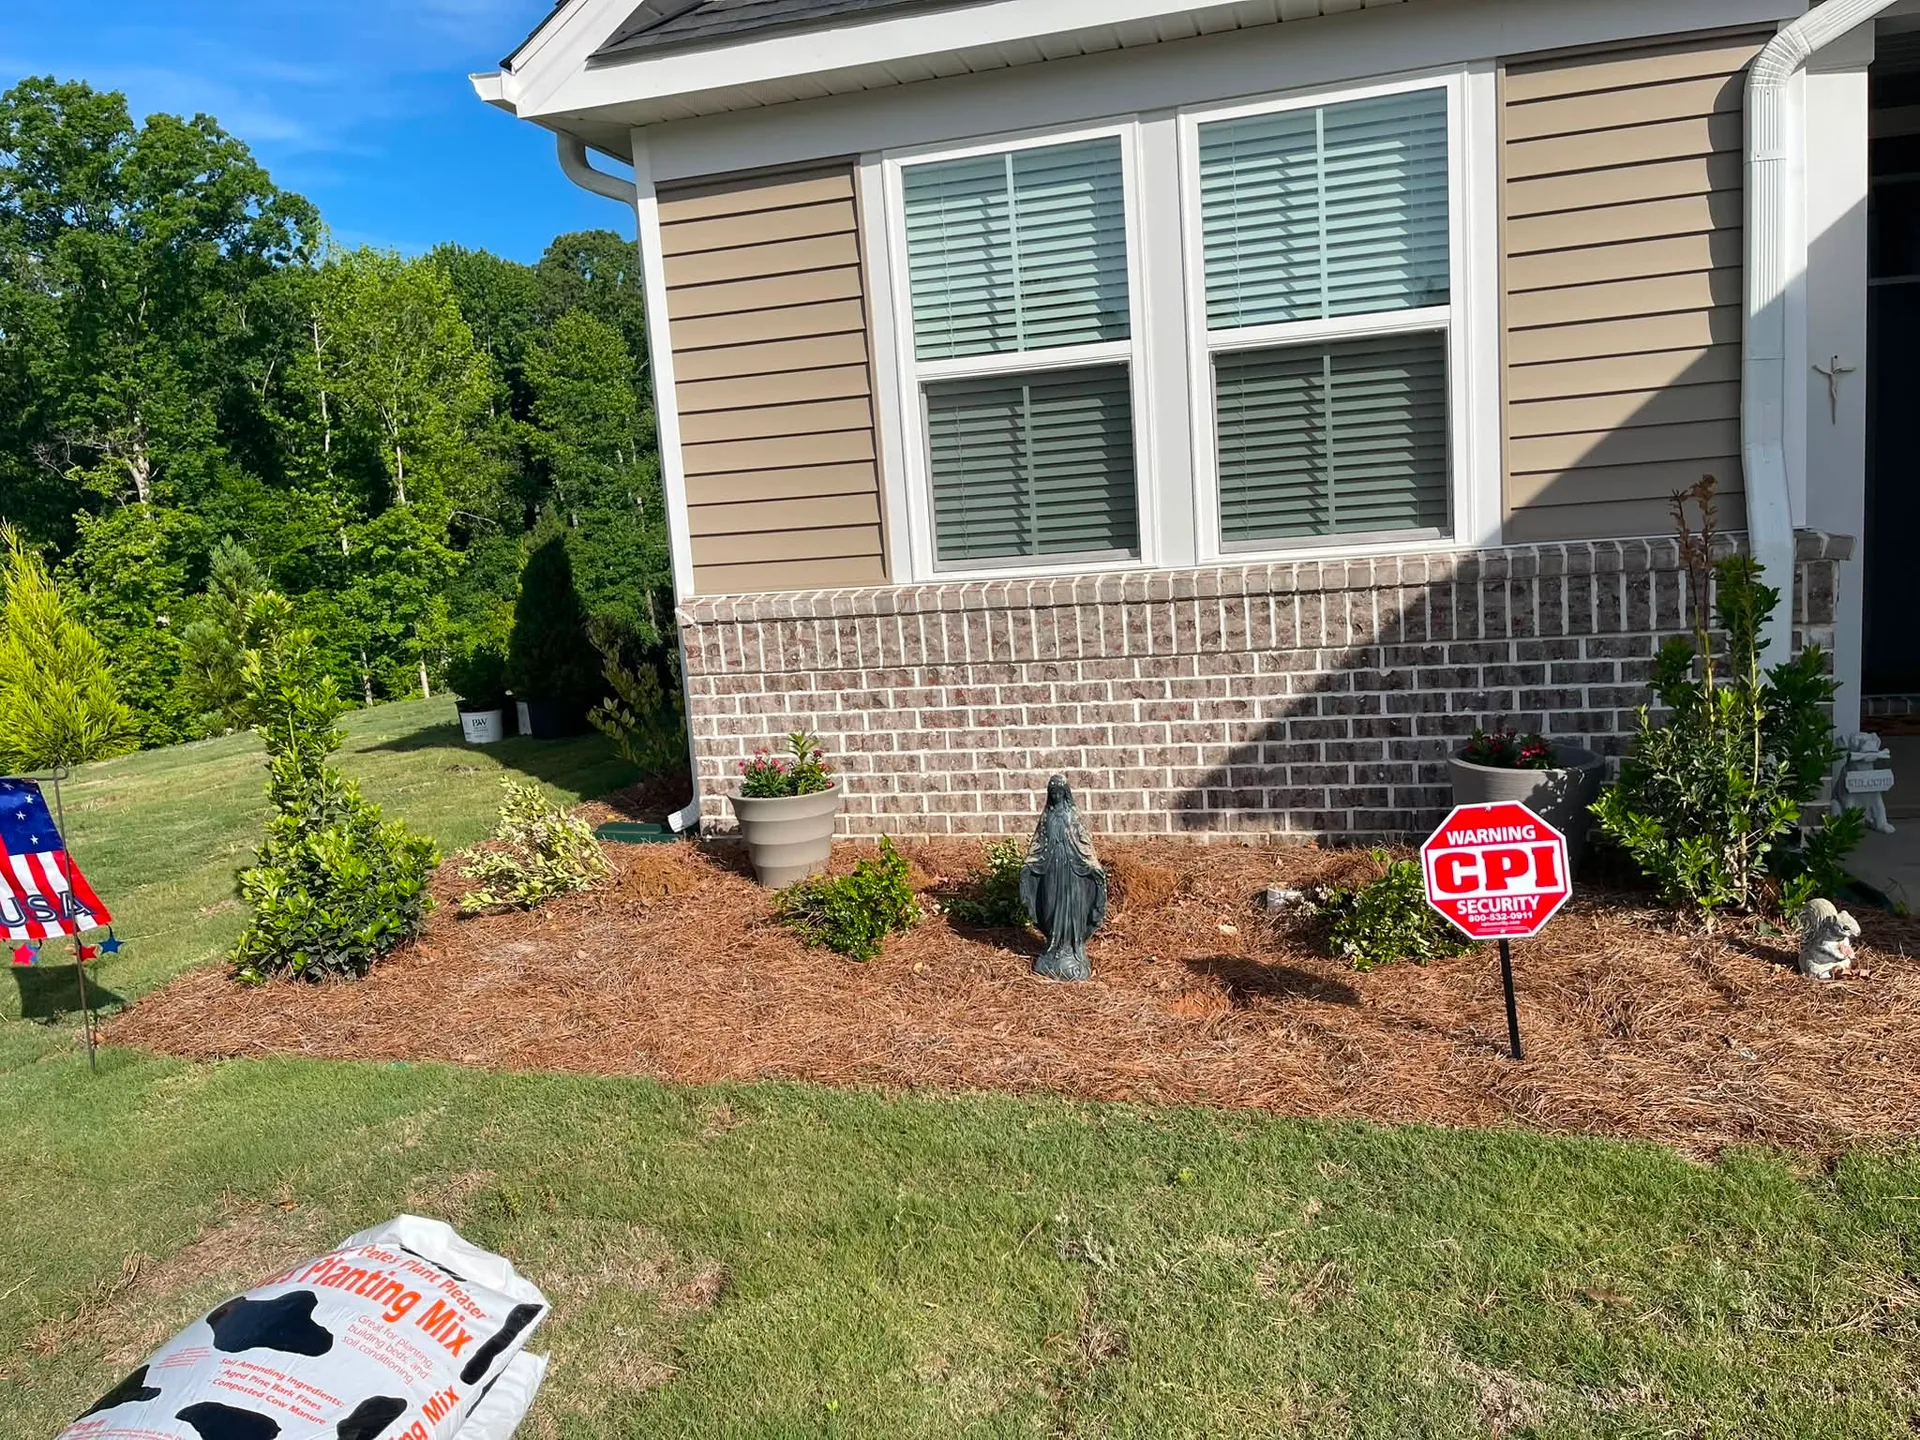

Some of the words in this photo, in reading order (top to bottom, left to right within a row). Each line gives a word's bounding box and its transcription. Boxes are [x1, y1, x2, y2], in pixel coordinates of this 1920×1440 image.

[1446, 825, 1536, 845] WARNING
[1434, 846, 1558, 893] CPI
[0, 890, 99, 928] USA
[1456, 895, 1540, 915] SECURITY
[1468, 911, 1532, 922] 800-532-0911
[297, 1257, 422, 1323] Planting
[415, 1298, 474, 1358] Mix
[399, 1259, 442, 1283] Plant
[438, 1278, 486, 1319] Pleaser
[342, 1335, 361, 1349] soil
[358, 1314, 384, 1332] Great
[382, 1327, 399, 1340] for
[348, 1324, 385, 1349] building
[409, 1362, 431, 1380] and
[211, 1378, 266, 1398] Composted
[264, 1394, 289, 1408] Cow
[288, 1405, 326, 1425] Manure
[220, 1357, 238, 1366] Soil
[237, 1360, 285, 1381] Amending
[287, 1375, 345, 1408] Ingredients:
[221, 1369, 248, 1380] Aged
[248, 1374, 271, 1388] Pine
[270, 1382, 296, 1398] Bark
[295, 1393, 324, 1411] Fines
[421, 1384, 460, 1426] Mix
